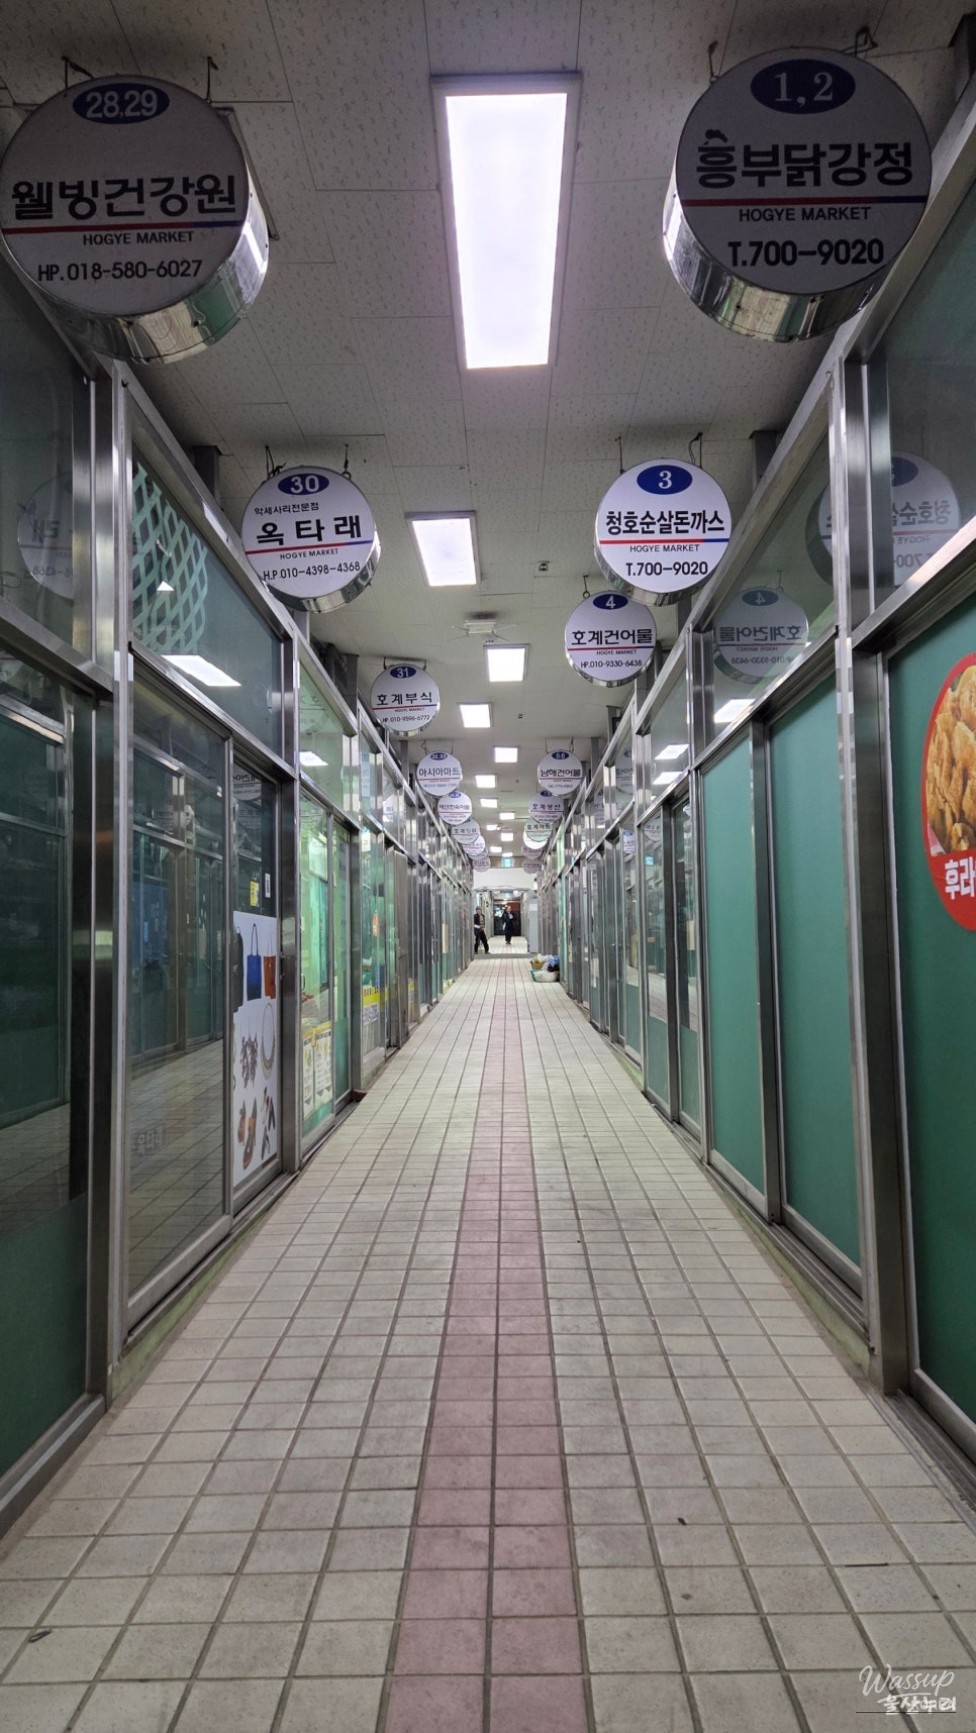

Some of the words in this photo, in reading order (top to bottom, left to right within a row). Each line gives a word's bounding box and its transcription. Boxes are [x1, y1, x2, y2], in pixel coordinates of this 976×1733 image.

[85, 90, 158, 119] 28,29
[696, 132, 912, 188] 흥부닭강정
[12, 174, 236, 220] 웰빙건강원
[739, 208, 795, 222] HOGYE
[801, 206, 872, 221] MARKET
[82, 232, 132, 246] HOGYE
[136, 230, 194, 244] MARKET
[728, 238, 884, 268] T.700-9020
[38, 260, 202, 282] HP.018-580-6027
[290, 474, 320, 494] 30
[658, 470, 673, 490] 3
[254, 502, 320, 516] 악세사리전문점
[606, 510, 725, 536] 청호순살돈까스
[280, 552, 307, 561] HOGYE
[309, 548, 339, 558] MARKET
[630, 544, 660, 553] HOGYE
[663, 544, 700, 552] MARKET
[625, 561, 708, 577] T.700-9020
[606, 595, 616, 609] 4
[572, 628, 652, 646] 호계건어물
[396, 667, 409, 678] 31
[376, 692, 432, 706] 호계부식
[944, 856, 976, 900] 후라
